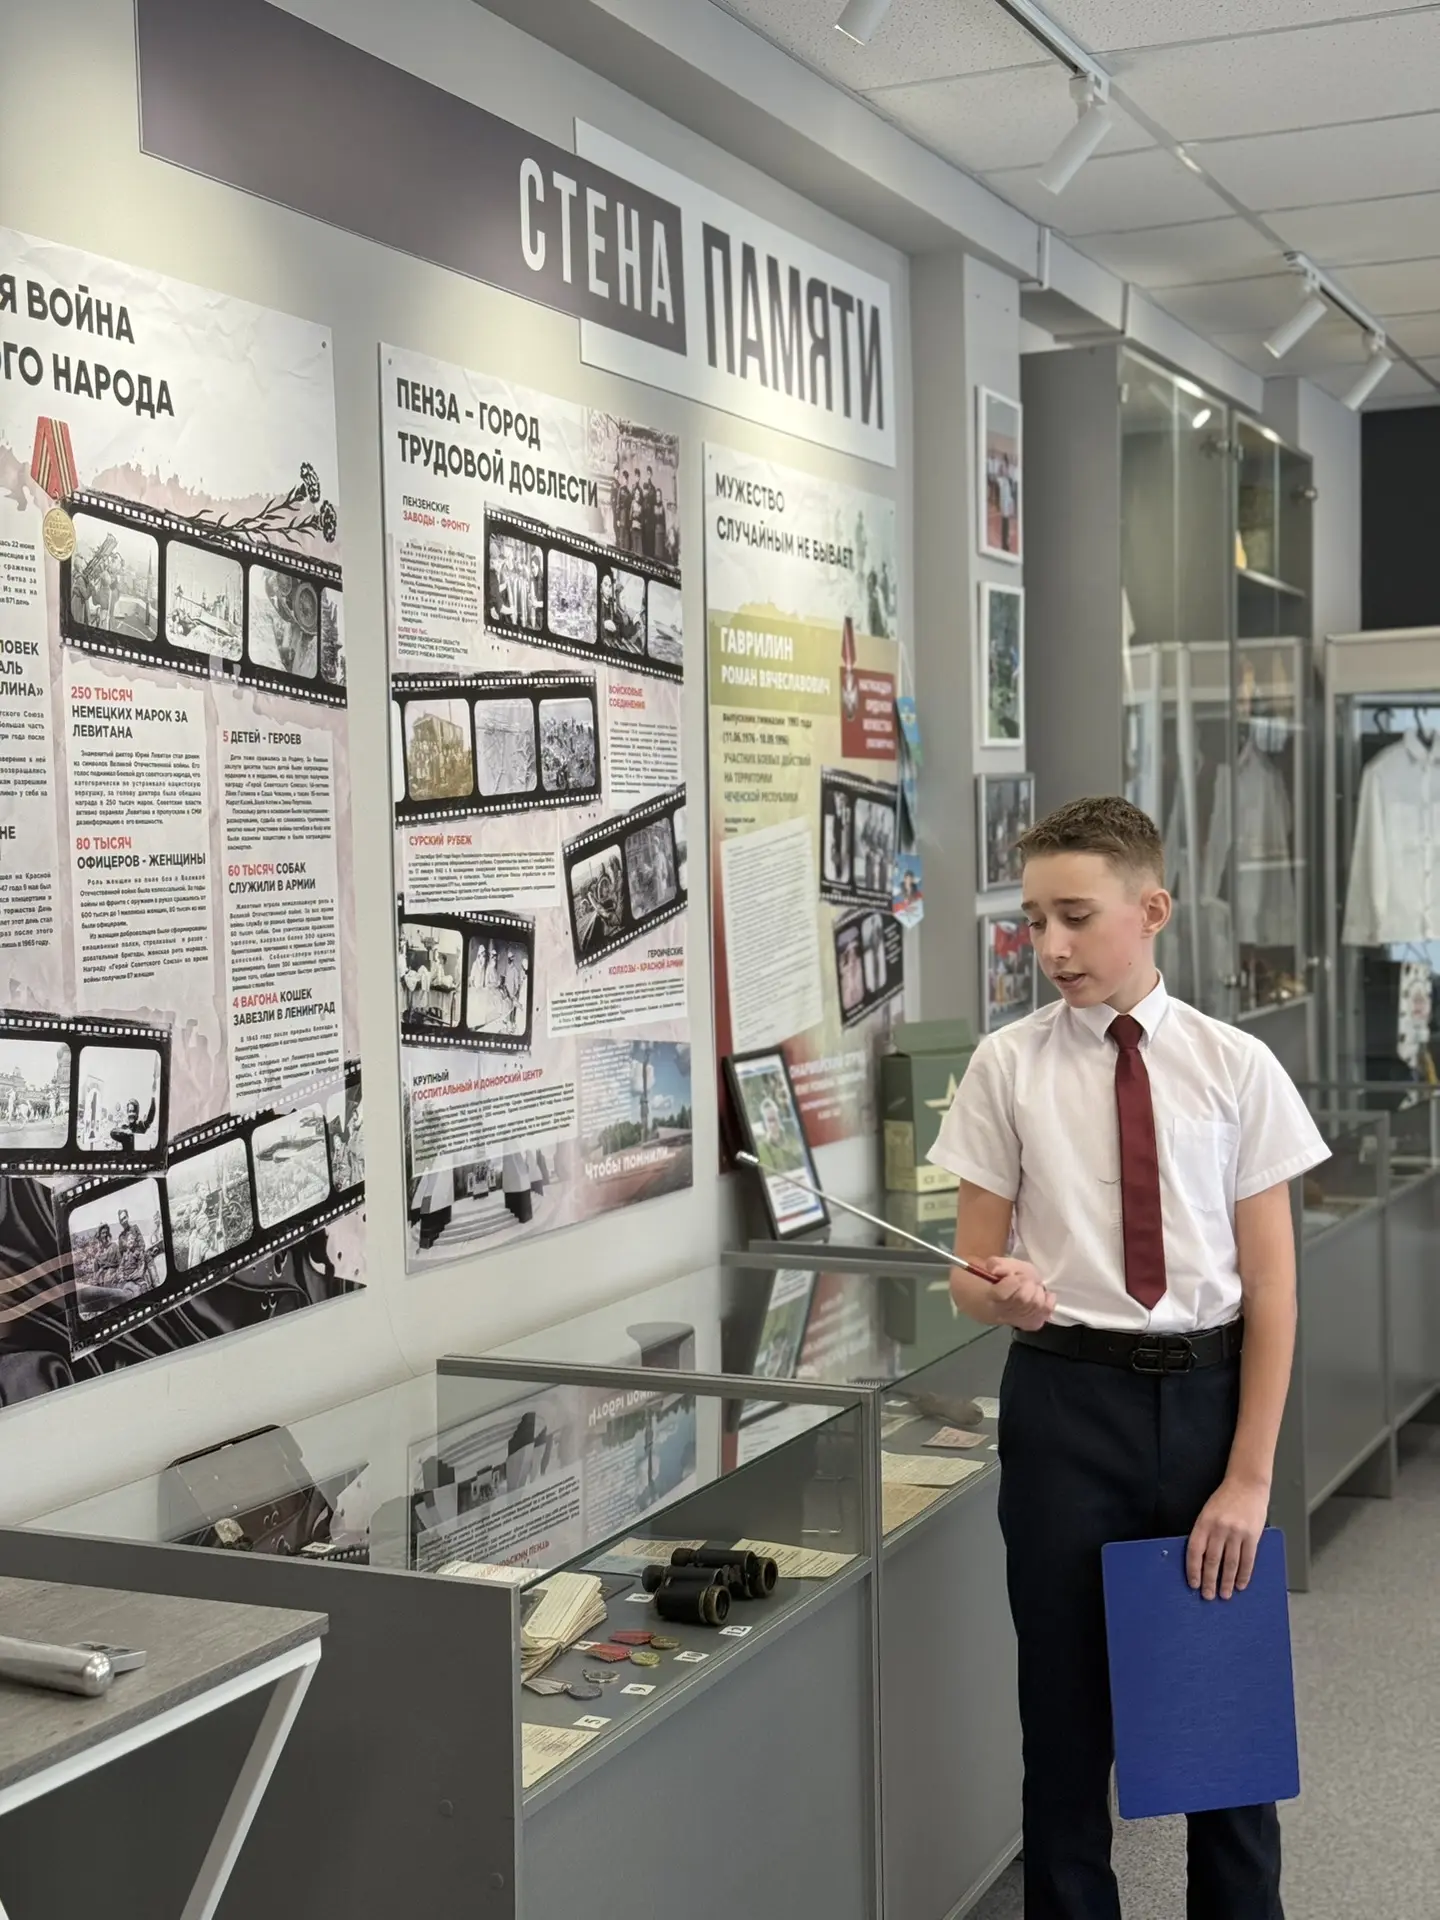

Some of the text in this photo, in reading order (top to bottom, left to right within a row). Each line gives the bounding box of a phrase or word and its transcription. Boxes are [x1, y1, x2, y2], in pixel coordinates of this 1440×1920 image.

[519, 158, 884, 430] СТЕНА ПАМЯТИ
[0, 274, 135, 344] Я ВОЙНА
[0, 341, 174, 419] ГО НАРОДА
[397, 377, 460, 424] ПЕНЗА
[479, 402, 540, 451] ГОРОД
[398, 431, 598, 508] ТРУДОВОЙ ДОБЛЕСТИ
[716, 472, 784, 512] МУЖЕСТВО
[403, 495, 450, 514] ПЕНЗЕНСКИЕ
[403, 511, 435, 527] ЗАВОДЫ
[442, 520, 470, 533] ФРОНТУ
[717, 516, 853, 570] СЛУЧАЙНЫМ НЕ БЫВАЕТ
[721, 627, 793, 661] ГАВРИЛИН
[722, 665, 757, 685] РОМАН
[71, 686, 132, 701] 250 ТЫСЯЧ
[72, 705, 188, 723] НЕМЕЦКИХ МАРОК ЗА
[73, 724, 133, 738] ЛЕВИТАНА
[223, 731, 229, 742] 5
[231, 729, 260, 744] ДЕТЕЙ
[268, 733, 301, 744] ГЕРОЕВ
[76, 837, 131, 850] 80 ТЫСЯЧ
[409, 833, 472, 846] СУРСКИЙ РУБЕЖ
[77, 855, 139, 870] ОФИЦЕРОВ
[149, 853, 205, 866] ЖЕНЩИНЫ
[228, 862, 306, 876] 60 ТЫСЯЧ СОБАК
[229, 879, 316, 894] СЛУЖИЛИ В АРМИИ
[648, 947, 683, 958] ГЕРОИЧЕСКИЕ
[608, 965, 635, 975] КОЛХОЗЫ
[640, 959, 665, 971] КРАСНОЙ
[233, 988, 312, 1008] 4 ВАГОНА КОШЕК
[234, 1002, 335, 1026] ЗАВЕЗЛИ В ЛЕНИНГРАД
[412, 1080, 472, 1101] ГОСПИТАЛЬНЫЙ
[480, 1070, 521, 1089] ДОНОРСКИЙ
[522, 1069, 543, 1081] ЦЕНТР
[413, 1069, 449, 1086] КРУПНЫЙ
[585, 1156, 620, 1179] Чтобы
